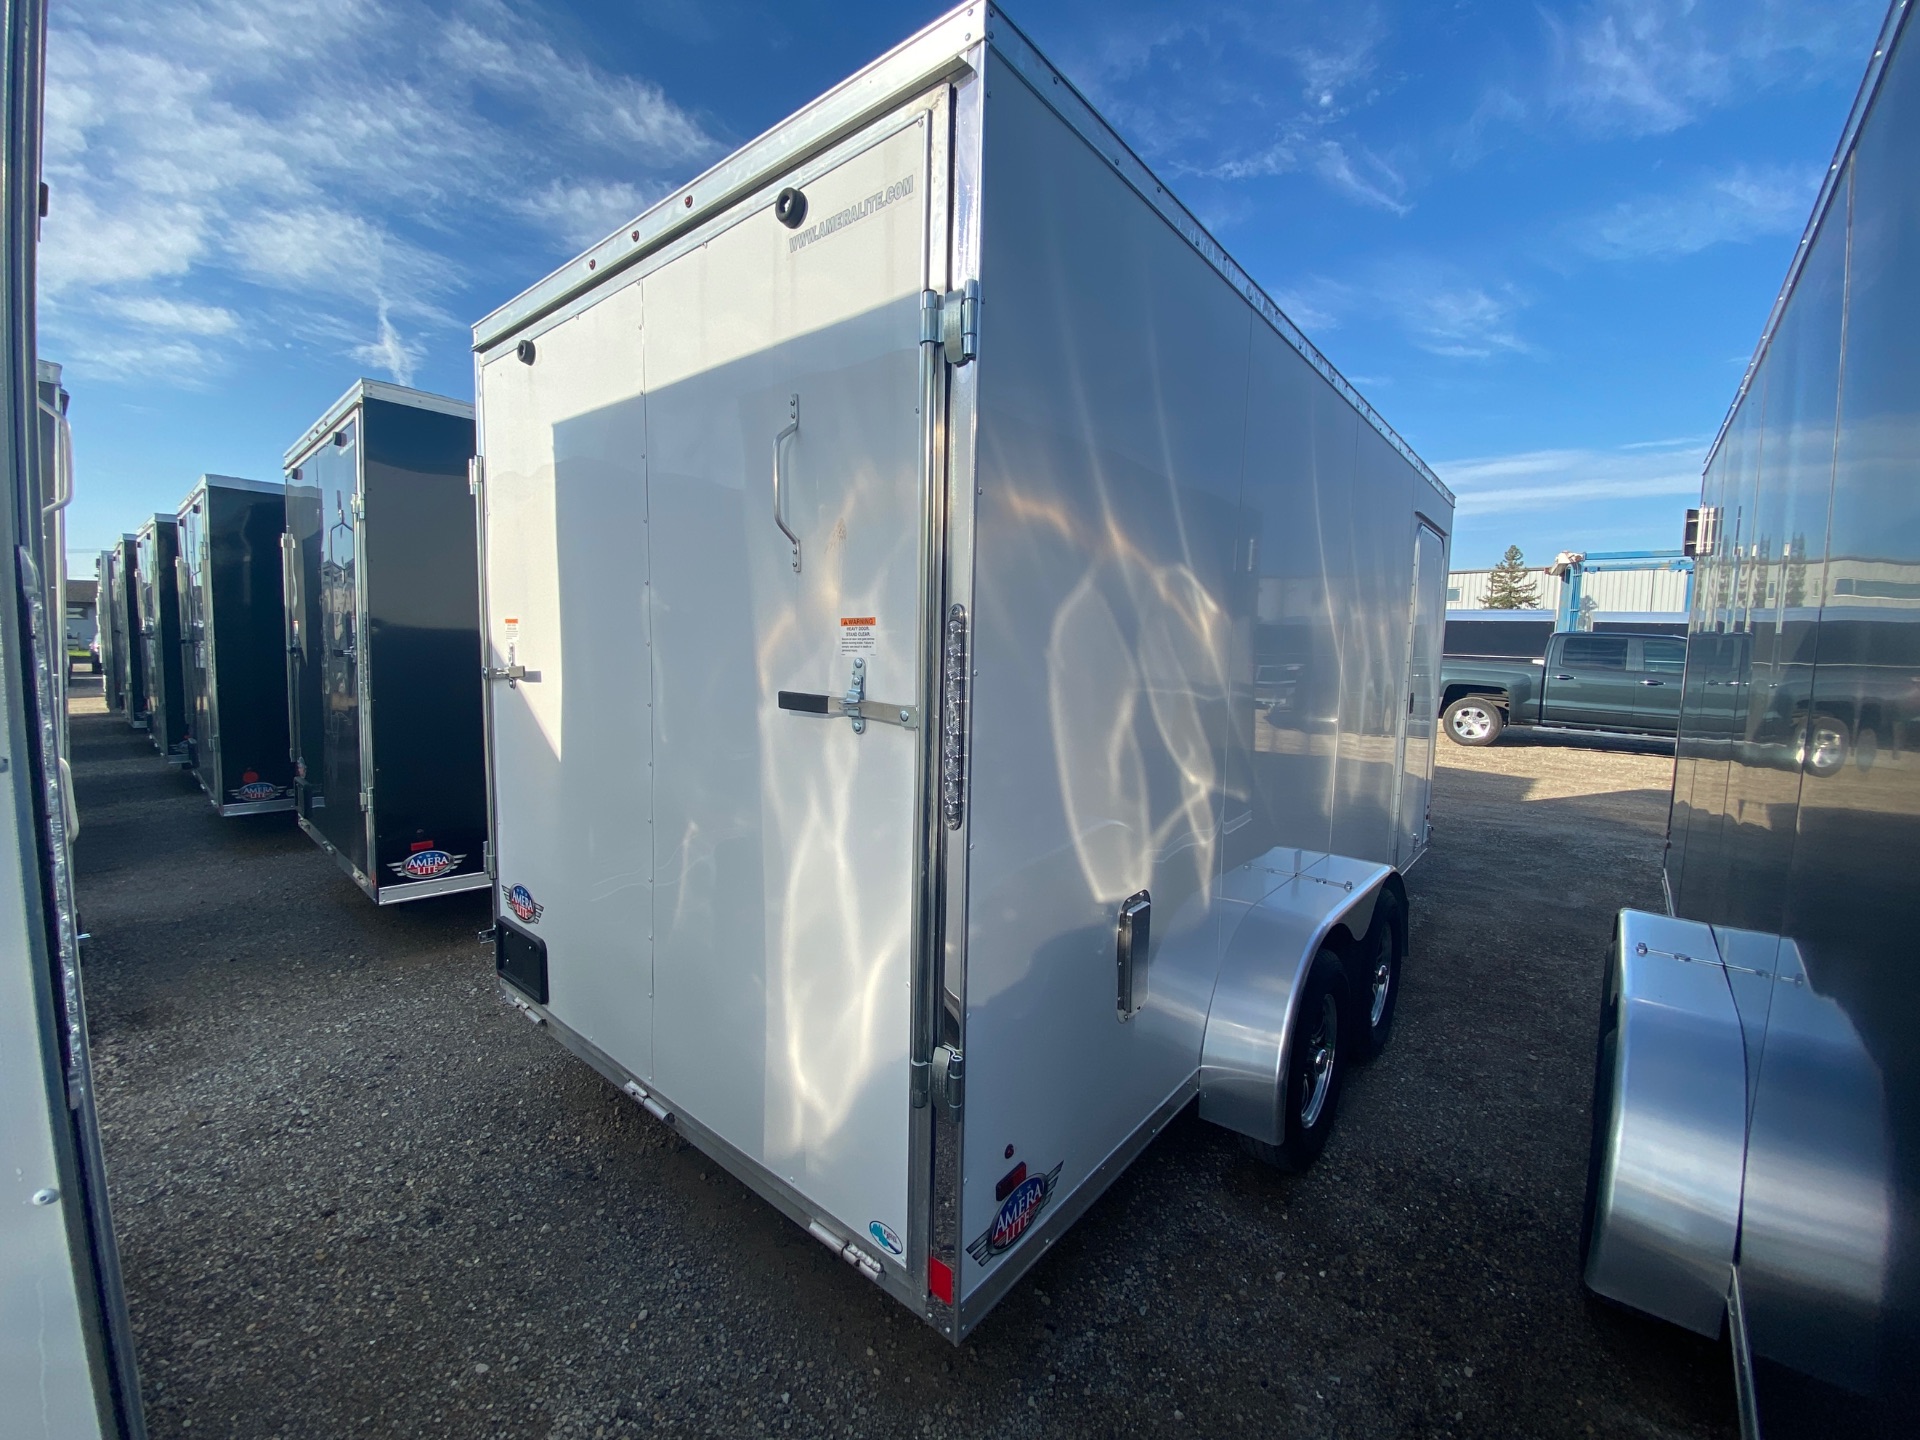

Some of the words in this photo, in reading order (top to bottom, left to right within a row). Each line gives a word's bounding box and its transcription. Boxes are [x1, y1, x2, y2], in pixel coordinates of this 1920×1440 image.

[788, 174, 914, 254] WWW.AMERALITE.COM
[848, 617, 874, 626] WARNING
[407, 856, 449, 869] AMERA
[417, 865, 439, 875] LITE
[511, 889, 534, 914] AMERA
[993, 1183, 1043, 1242] AMERA
[1005, 1209, 1031, 1245] LITE
